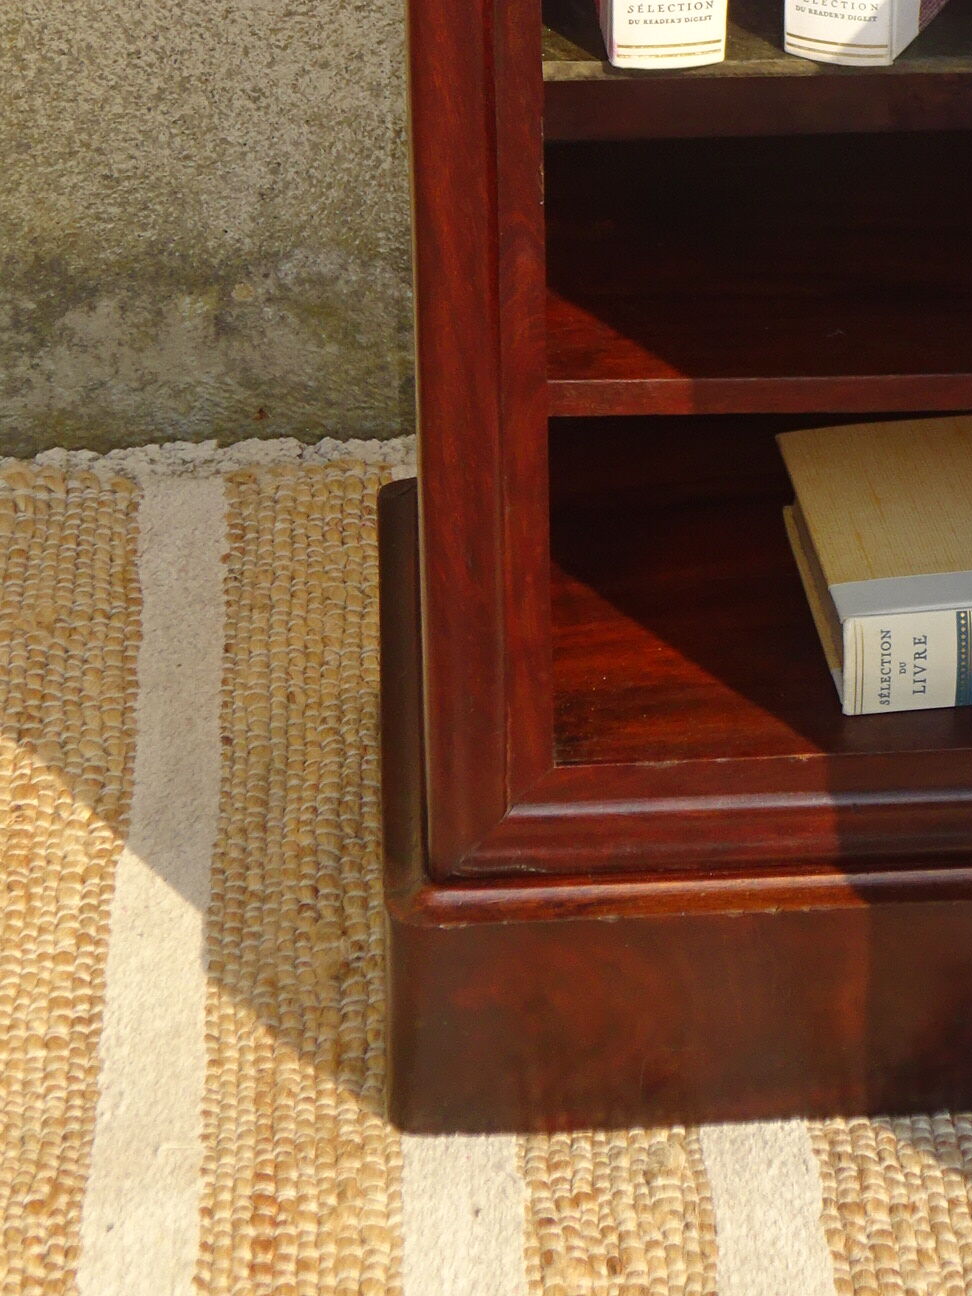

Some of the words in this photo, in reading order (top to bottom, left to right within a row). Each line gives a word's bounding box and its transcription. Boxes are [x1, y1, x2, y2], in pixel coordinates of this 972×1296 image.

[627, 0, 714, 14] SÉLECTION
[684, 15, 712, 23] DIGEST
[847, 14, 878, 22] DIGEST
[880, 629, 892, 705] SÉLECTION
[899, 661, 907, 674] DU
[913, 634, 928, 695] LIVRE
